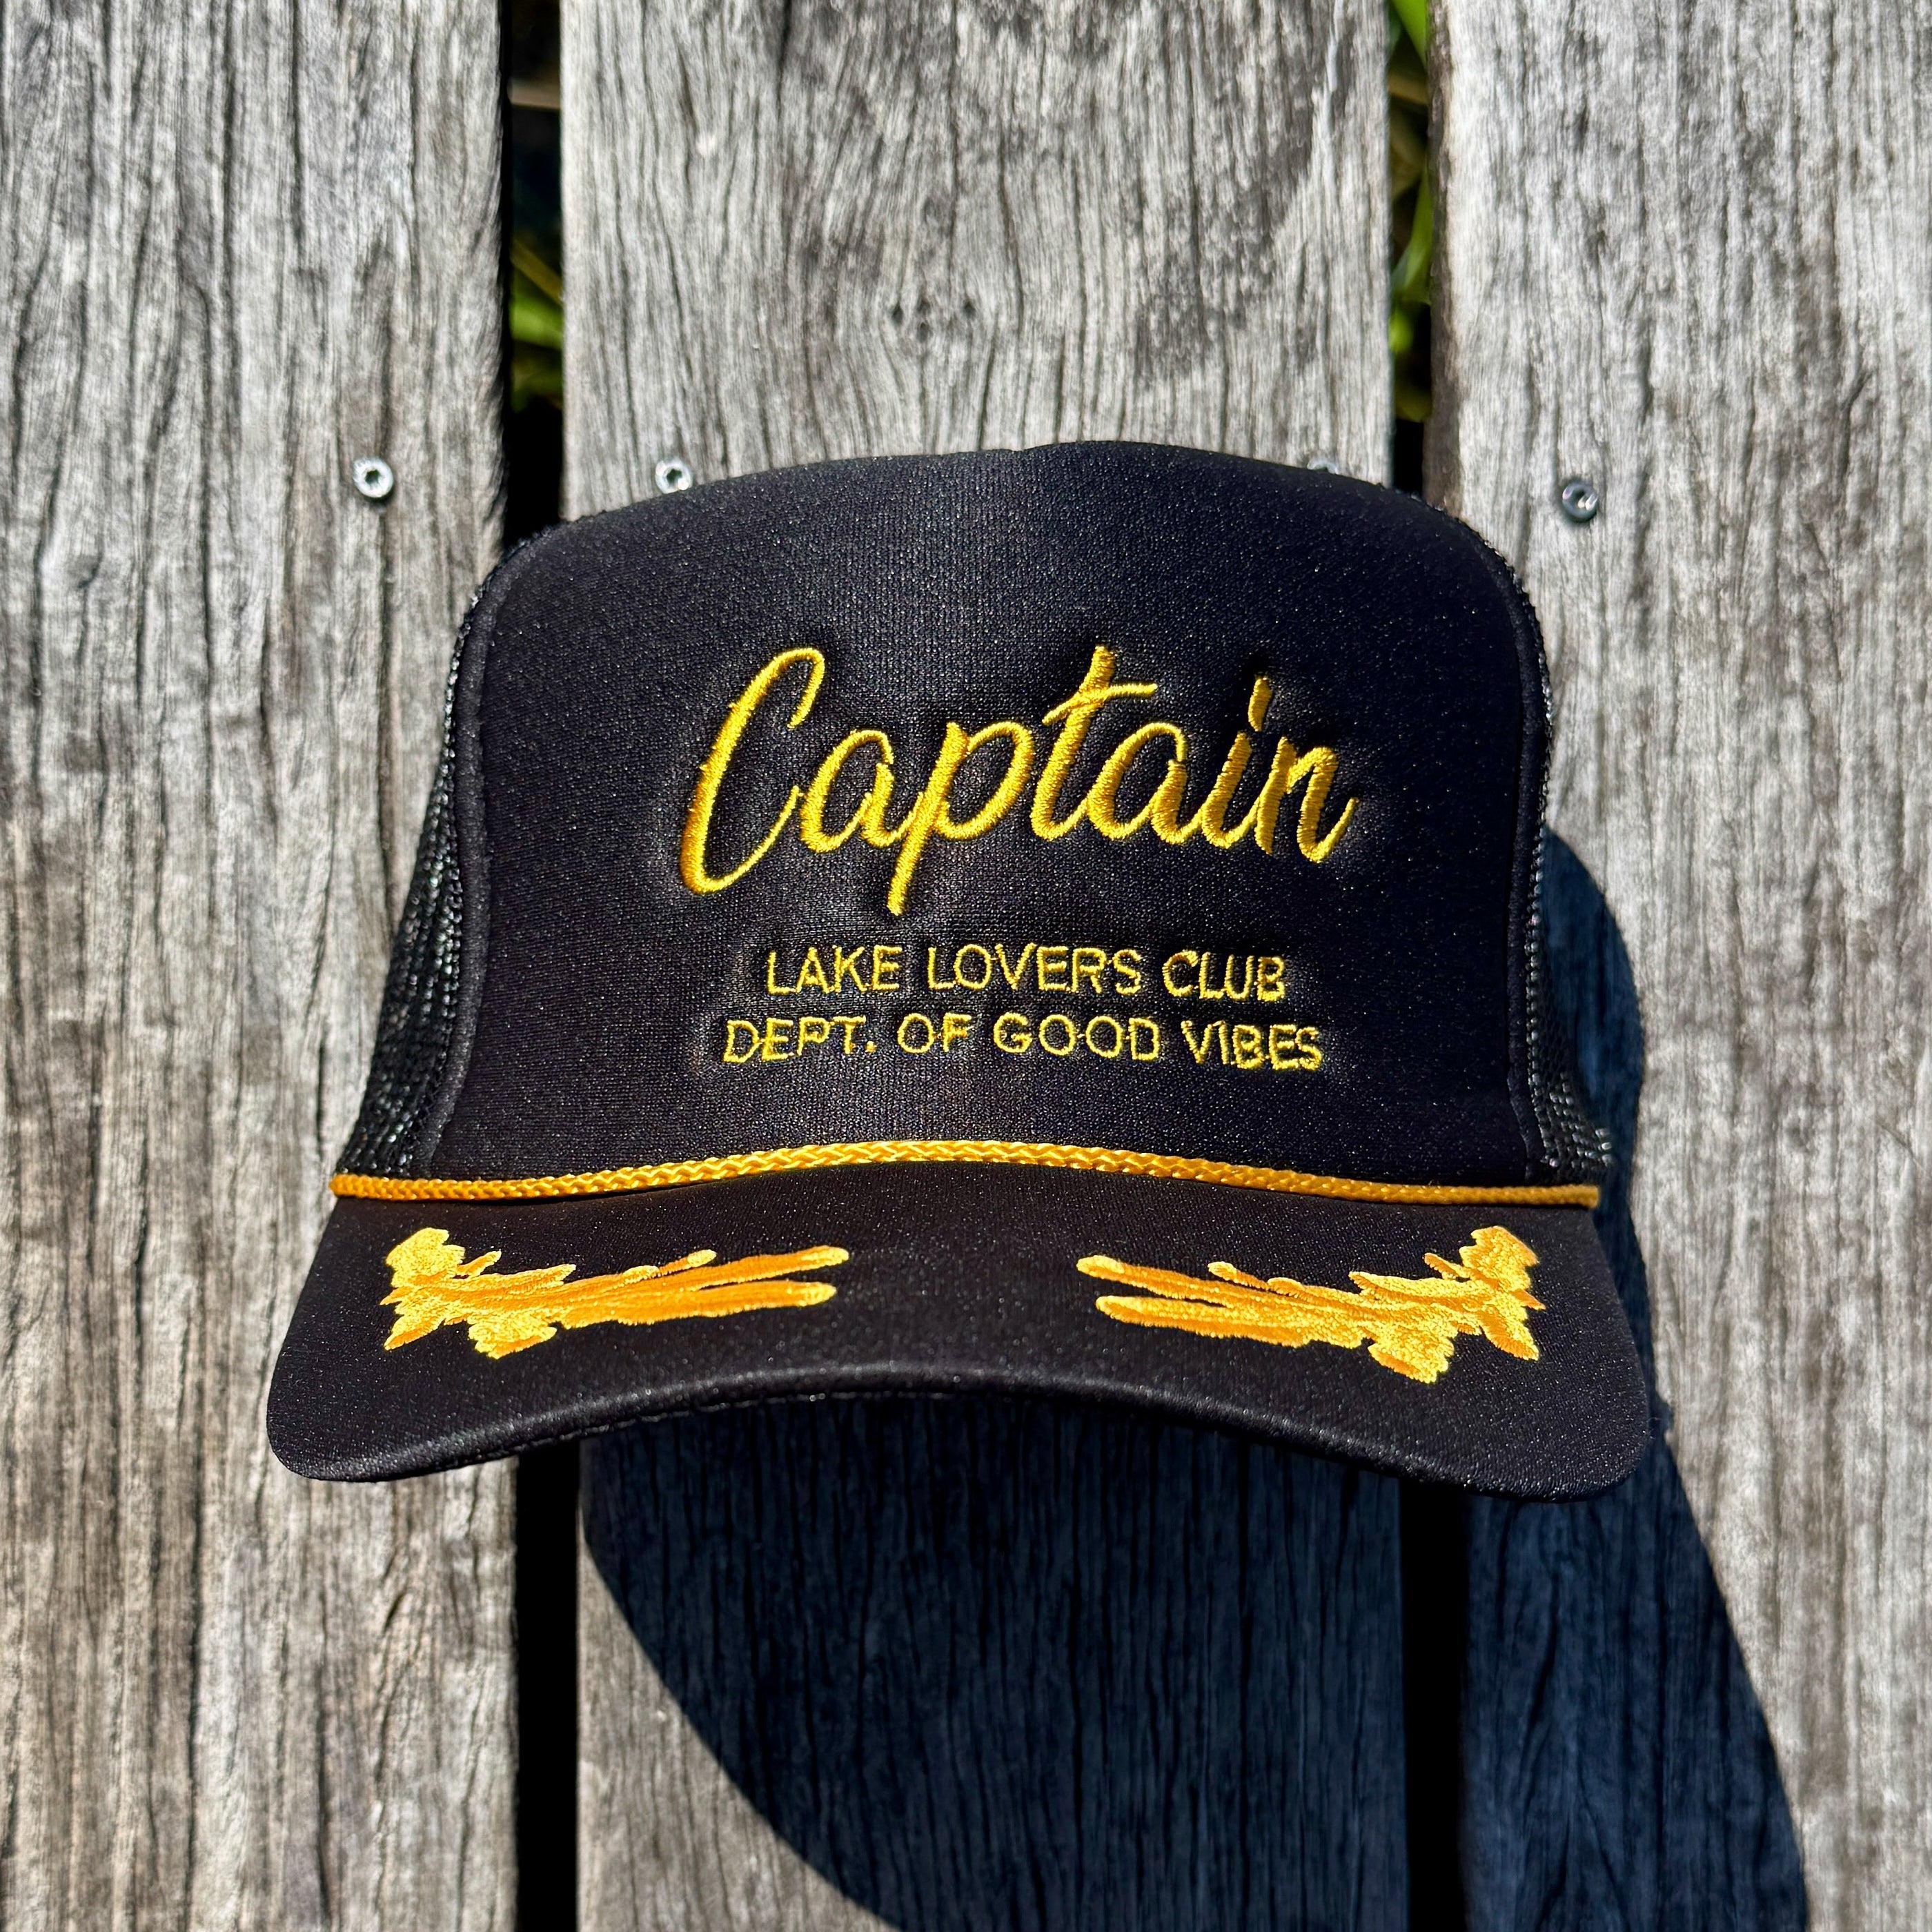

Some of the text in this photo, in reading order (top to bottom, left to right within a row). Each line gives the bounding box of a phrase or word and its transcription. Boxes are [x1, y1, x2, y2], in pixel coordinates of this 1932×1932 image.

[680, 644, 1357, 915] Captain
[766, 943, 1286, 1003] LAKE LOVERS CLUB
[722, 1014, 1323, 1072] DEPT. OF GOOD VIBES
